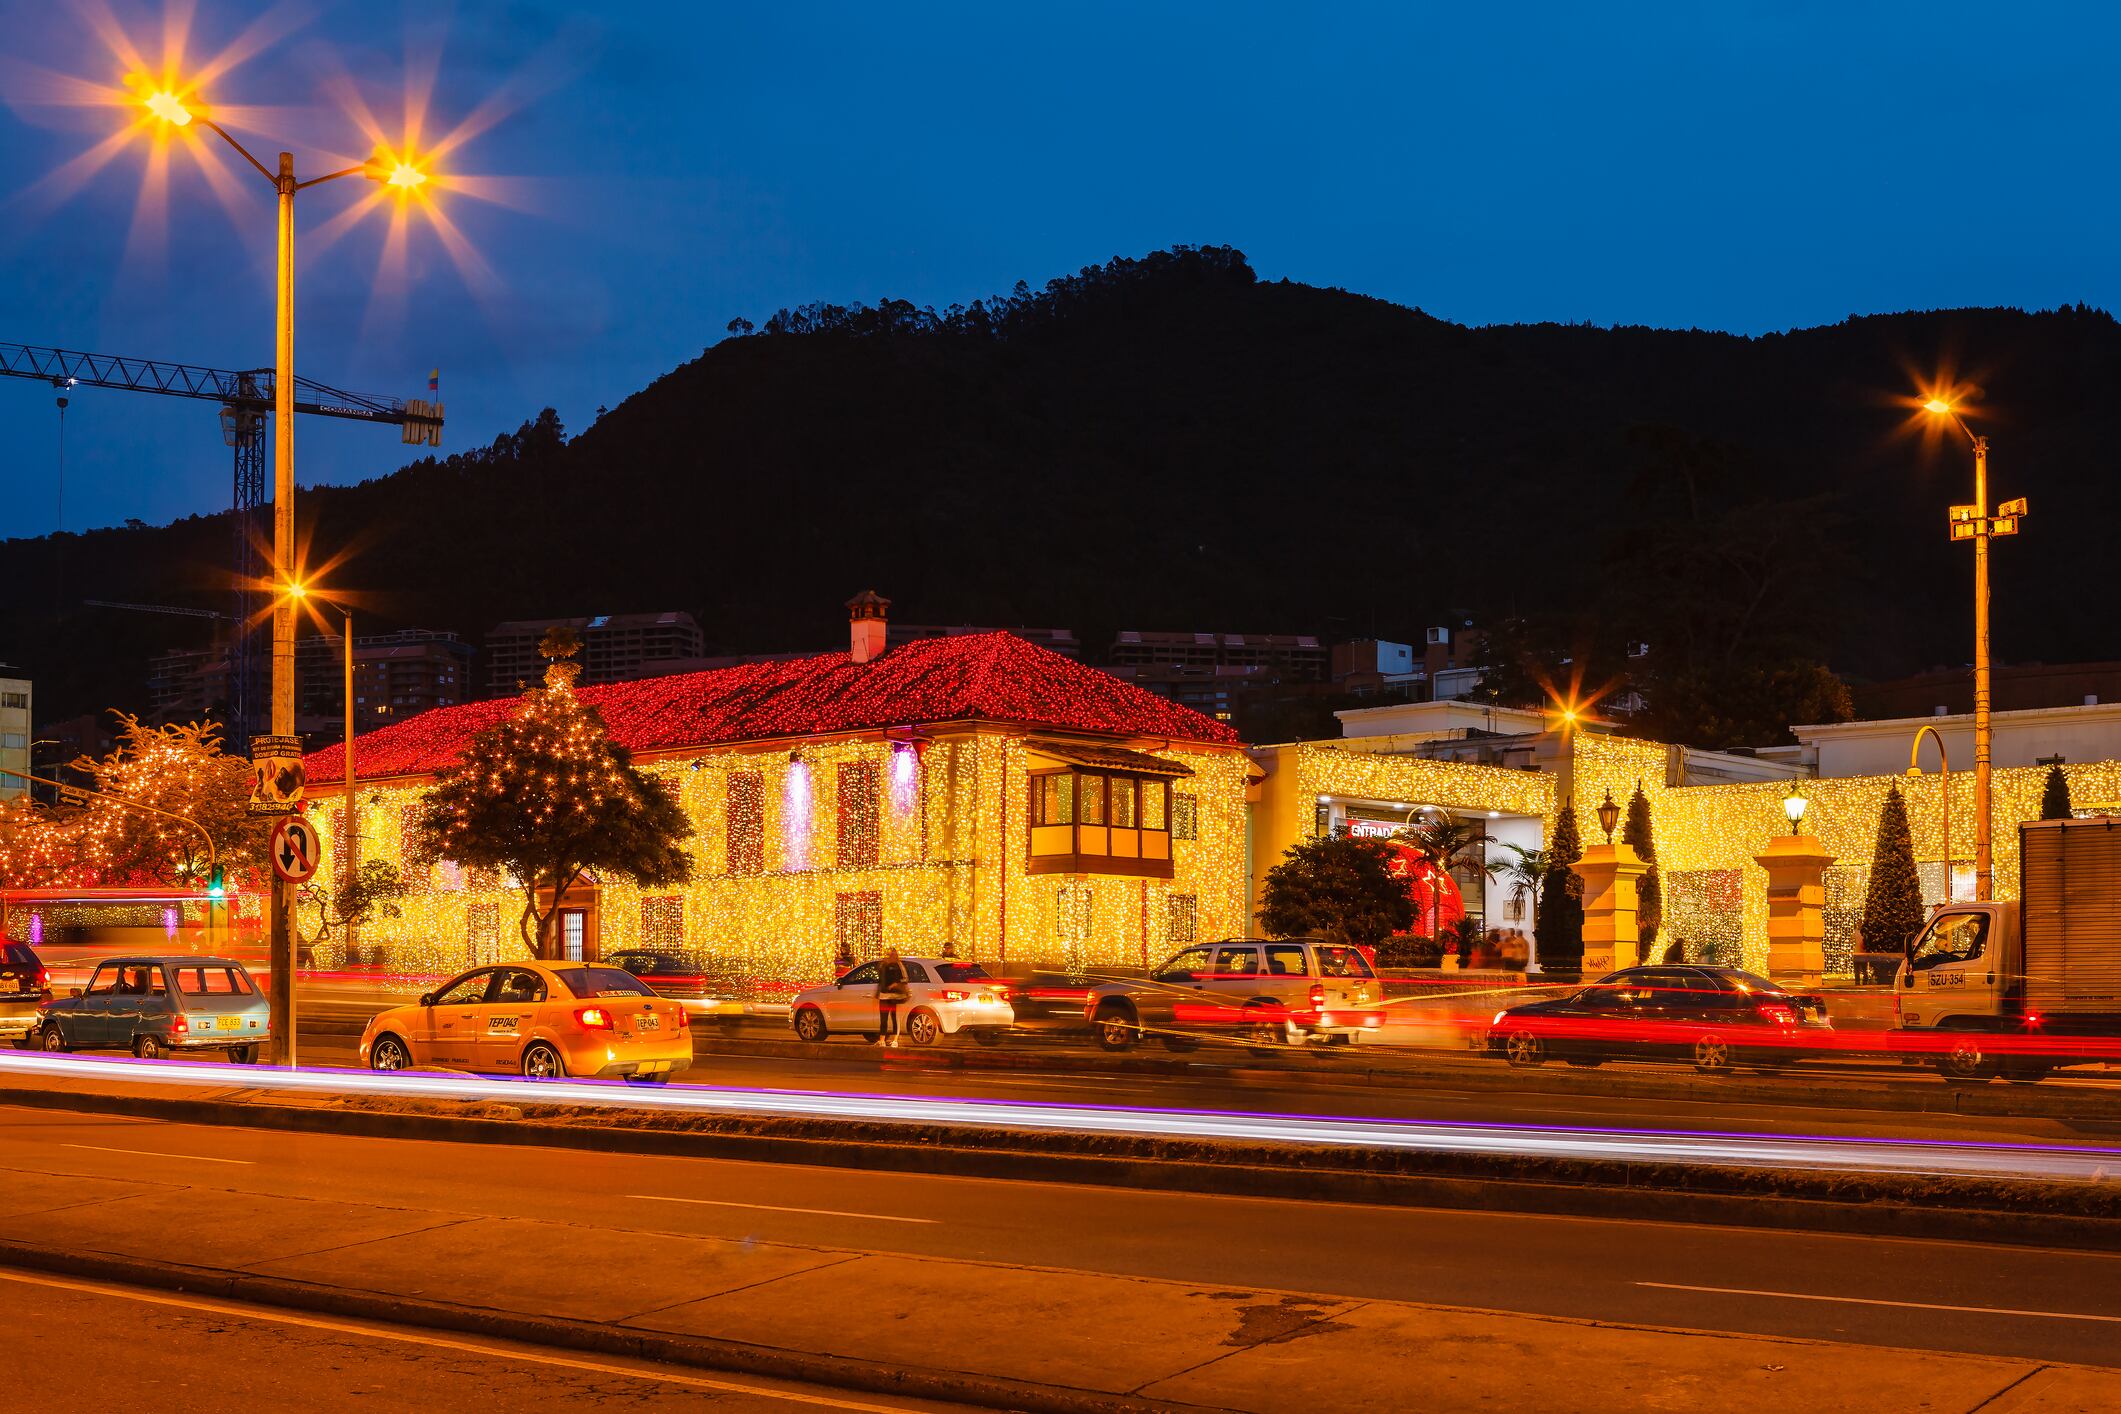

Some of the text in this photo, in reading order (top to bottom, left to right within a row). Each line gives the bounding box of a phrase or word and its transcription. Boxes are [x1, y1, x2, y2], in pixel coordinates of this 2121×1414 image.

[488, 1018, 519, 1027] TEP 043
[636, 1018, 658, 1027] TEP 043
